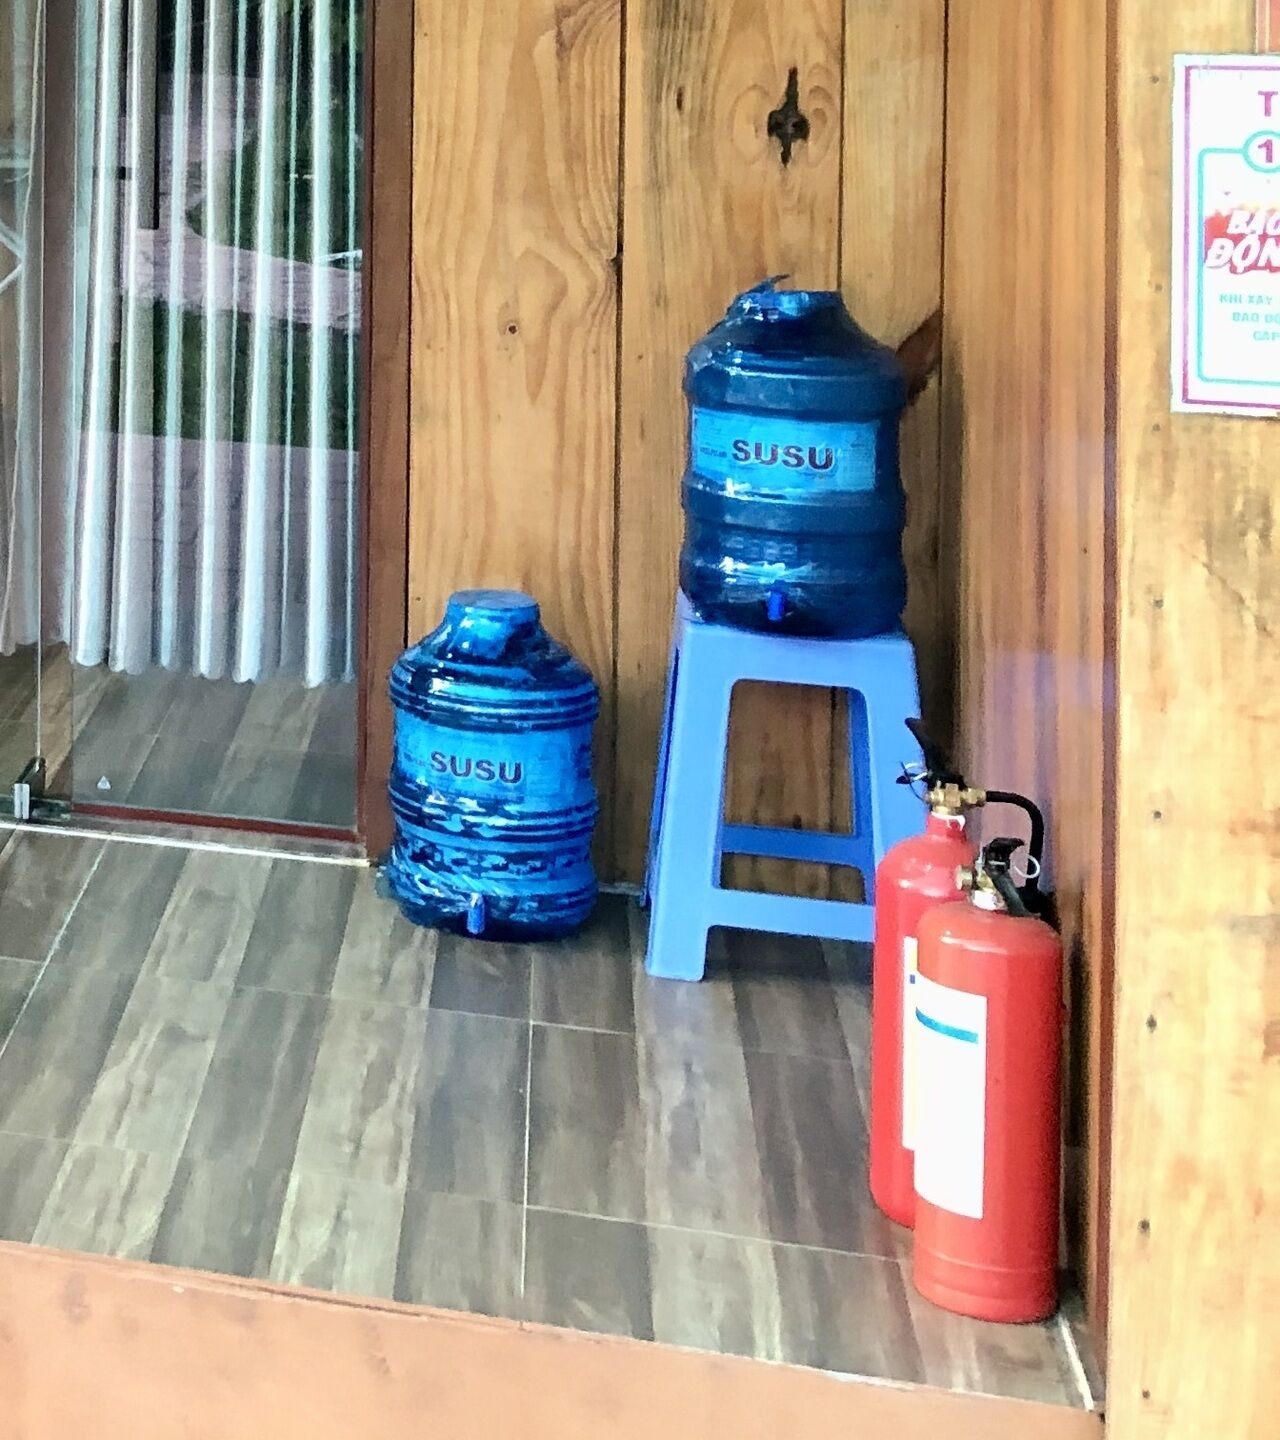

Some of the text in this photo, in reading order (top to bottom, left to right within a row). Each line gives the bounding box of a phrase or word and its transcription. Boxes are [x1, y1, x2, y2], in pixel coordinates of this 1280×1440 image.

[1257, 138, 1273, 163] 1
[732, 439, 834, 471] SUSU
[430, 750, 523, 784] SUSU
